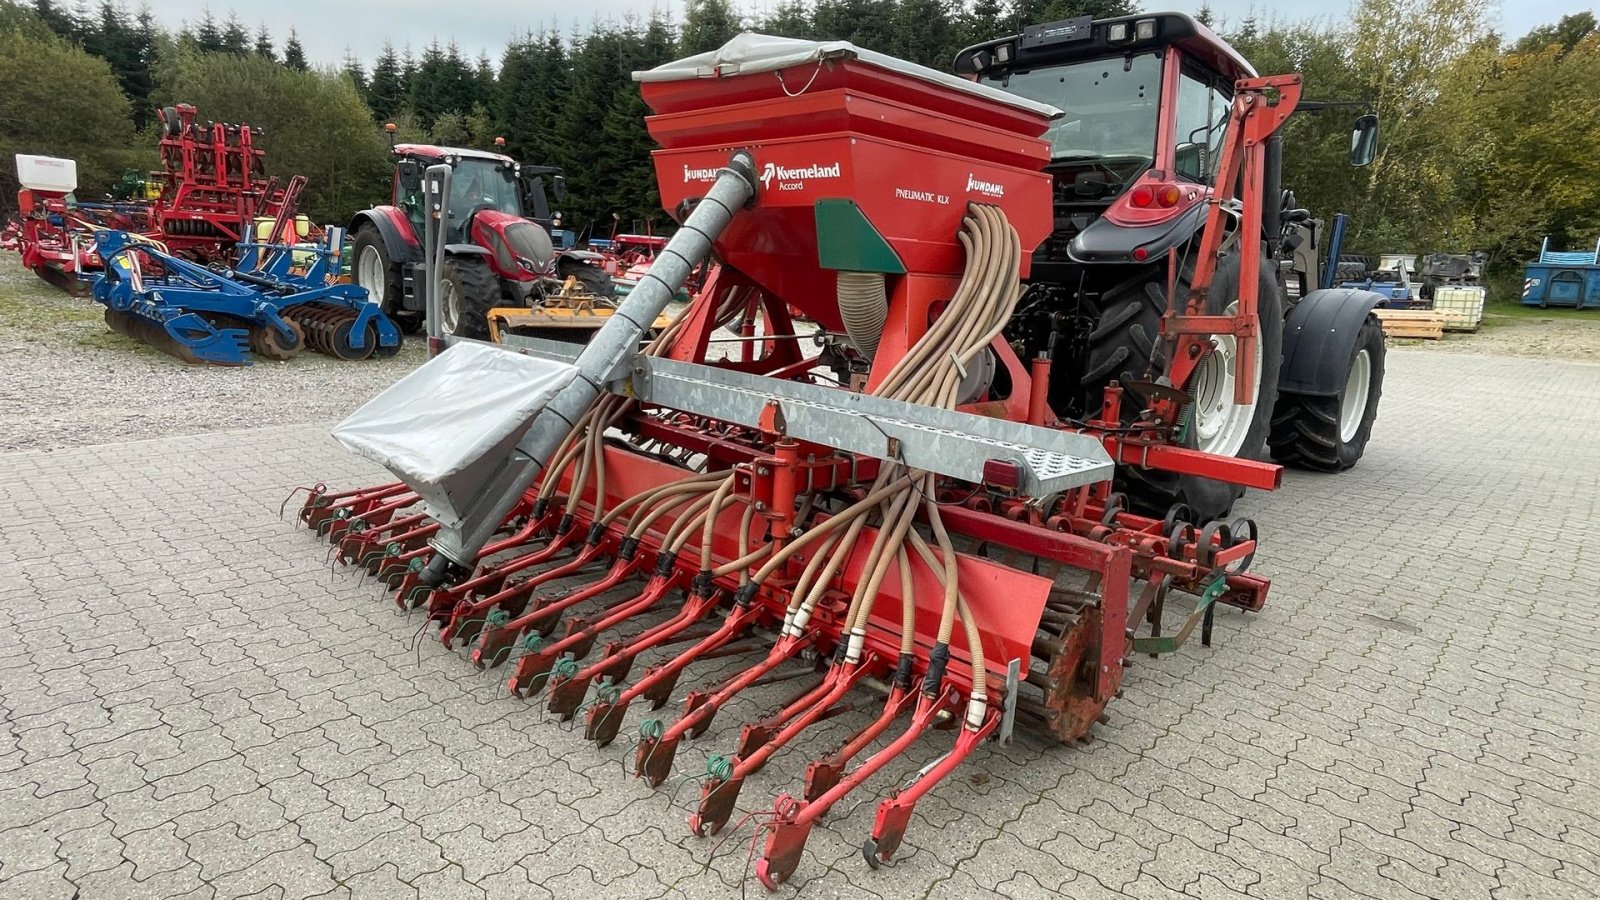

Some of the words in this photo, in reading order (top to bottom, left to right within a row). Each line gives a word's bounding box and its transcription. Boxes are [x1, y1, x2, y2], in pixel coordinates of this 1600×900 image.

[776, 162, 841, 180] Kverneland
[779, 181, 804, 191] Accord
[895, 188, 935, 203] PNEUMATIC
[937, 194, 950, 205] KLX
